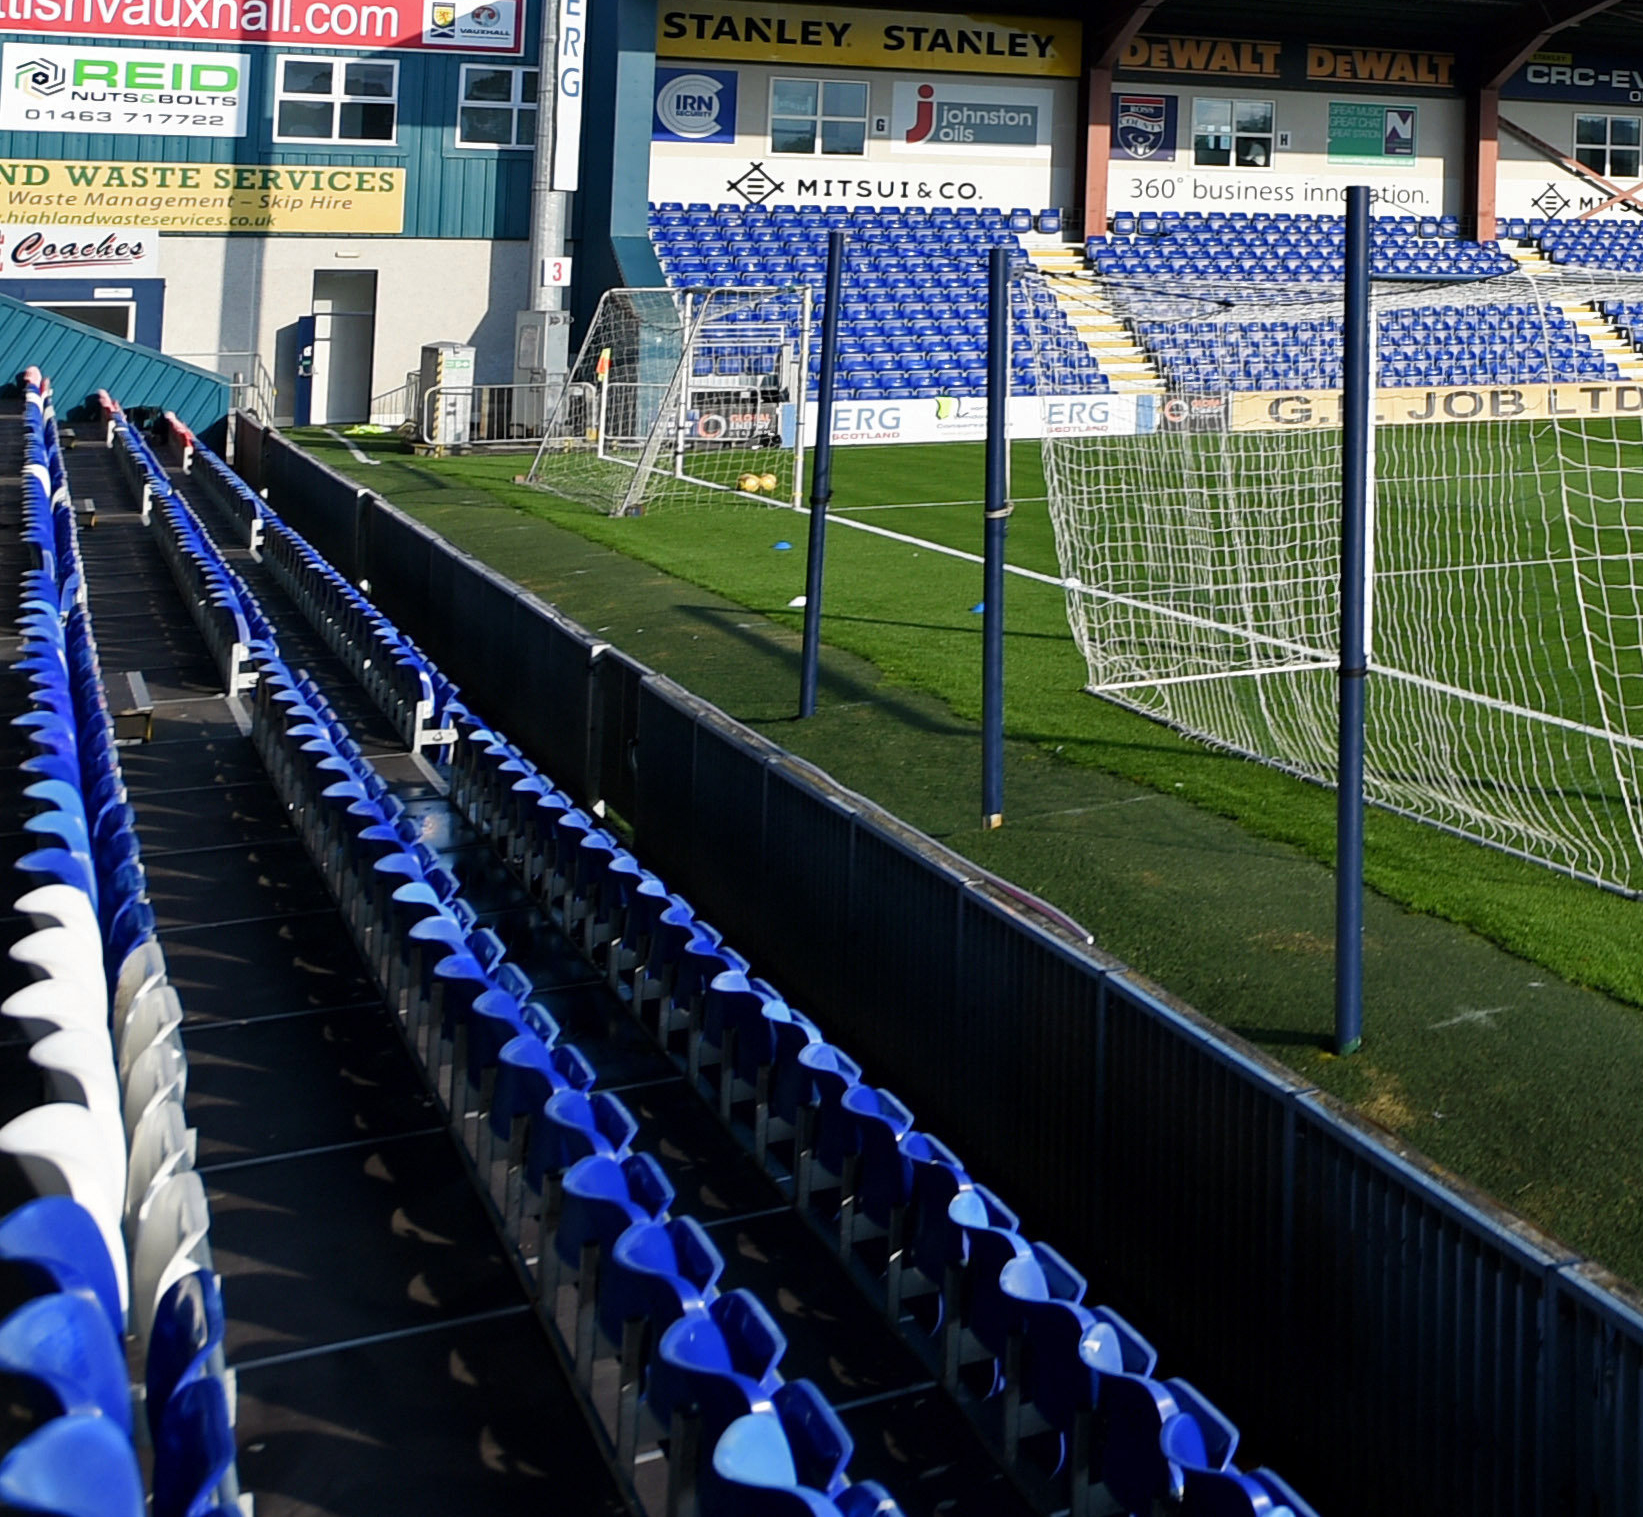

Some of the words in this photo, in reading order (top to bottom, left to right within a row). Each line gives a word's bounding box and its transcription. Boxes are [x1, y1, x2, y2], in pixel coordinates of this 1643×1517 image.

[460, 27, 511, 37] VAUXHALL
[663, 11, 848, 47] STANLEY
[883, 24, 1053, 58] STANLEY
[72, 58, 239, 92] REID
[71, 91, 237, 106] NUTS&BOLTS
[675, 93, 714, 112] IRN
[25, 108, 112, 122] 01463
[123, 112, 224, 126] 717722
[675, 110, 713, 119] SECURITY
[875, 118, 885, 132] G
[940, 104, 1032, 127] johnston
[939, 125, 974, 143] oils
[1280, 133, 1288, 147] H
[58, 165, 202, 189] WASTE
[213, 167, 395, 192] SERVICES
[797, 179, 908, 199] MITSUI
[1130, 176, 1184, 199] 360°
[1193, 179, 1294, 202] business
[1304, 182, 1430, 204] innoation.
[8, 190, 77, 207] Waste
[84, 192, 235, 213] Management
[258, 194, 303, 212] Skip
[311, 195, 353, 210] Hire
[11, 232, 146, 267] Coaches
[552, 262, 562, 282] 3
[1047, 401, 1110, 425] ERG
[1408, 389, 1525, 420] JOB
[832, 406, 901, 431] ERG
[832, 431, 901, 441] SCOTLAND
